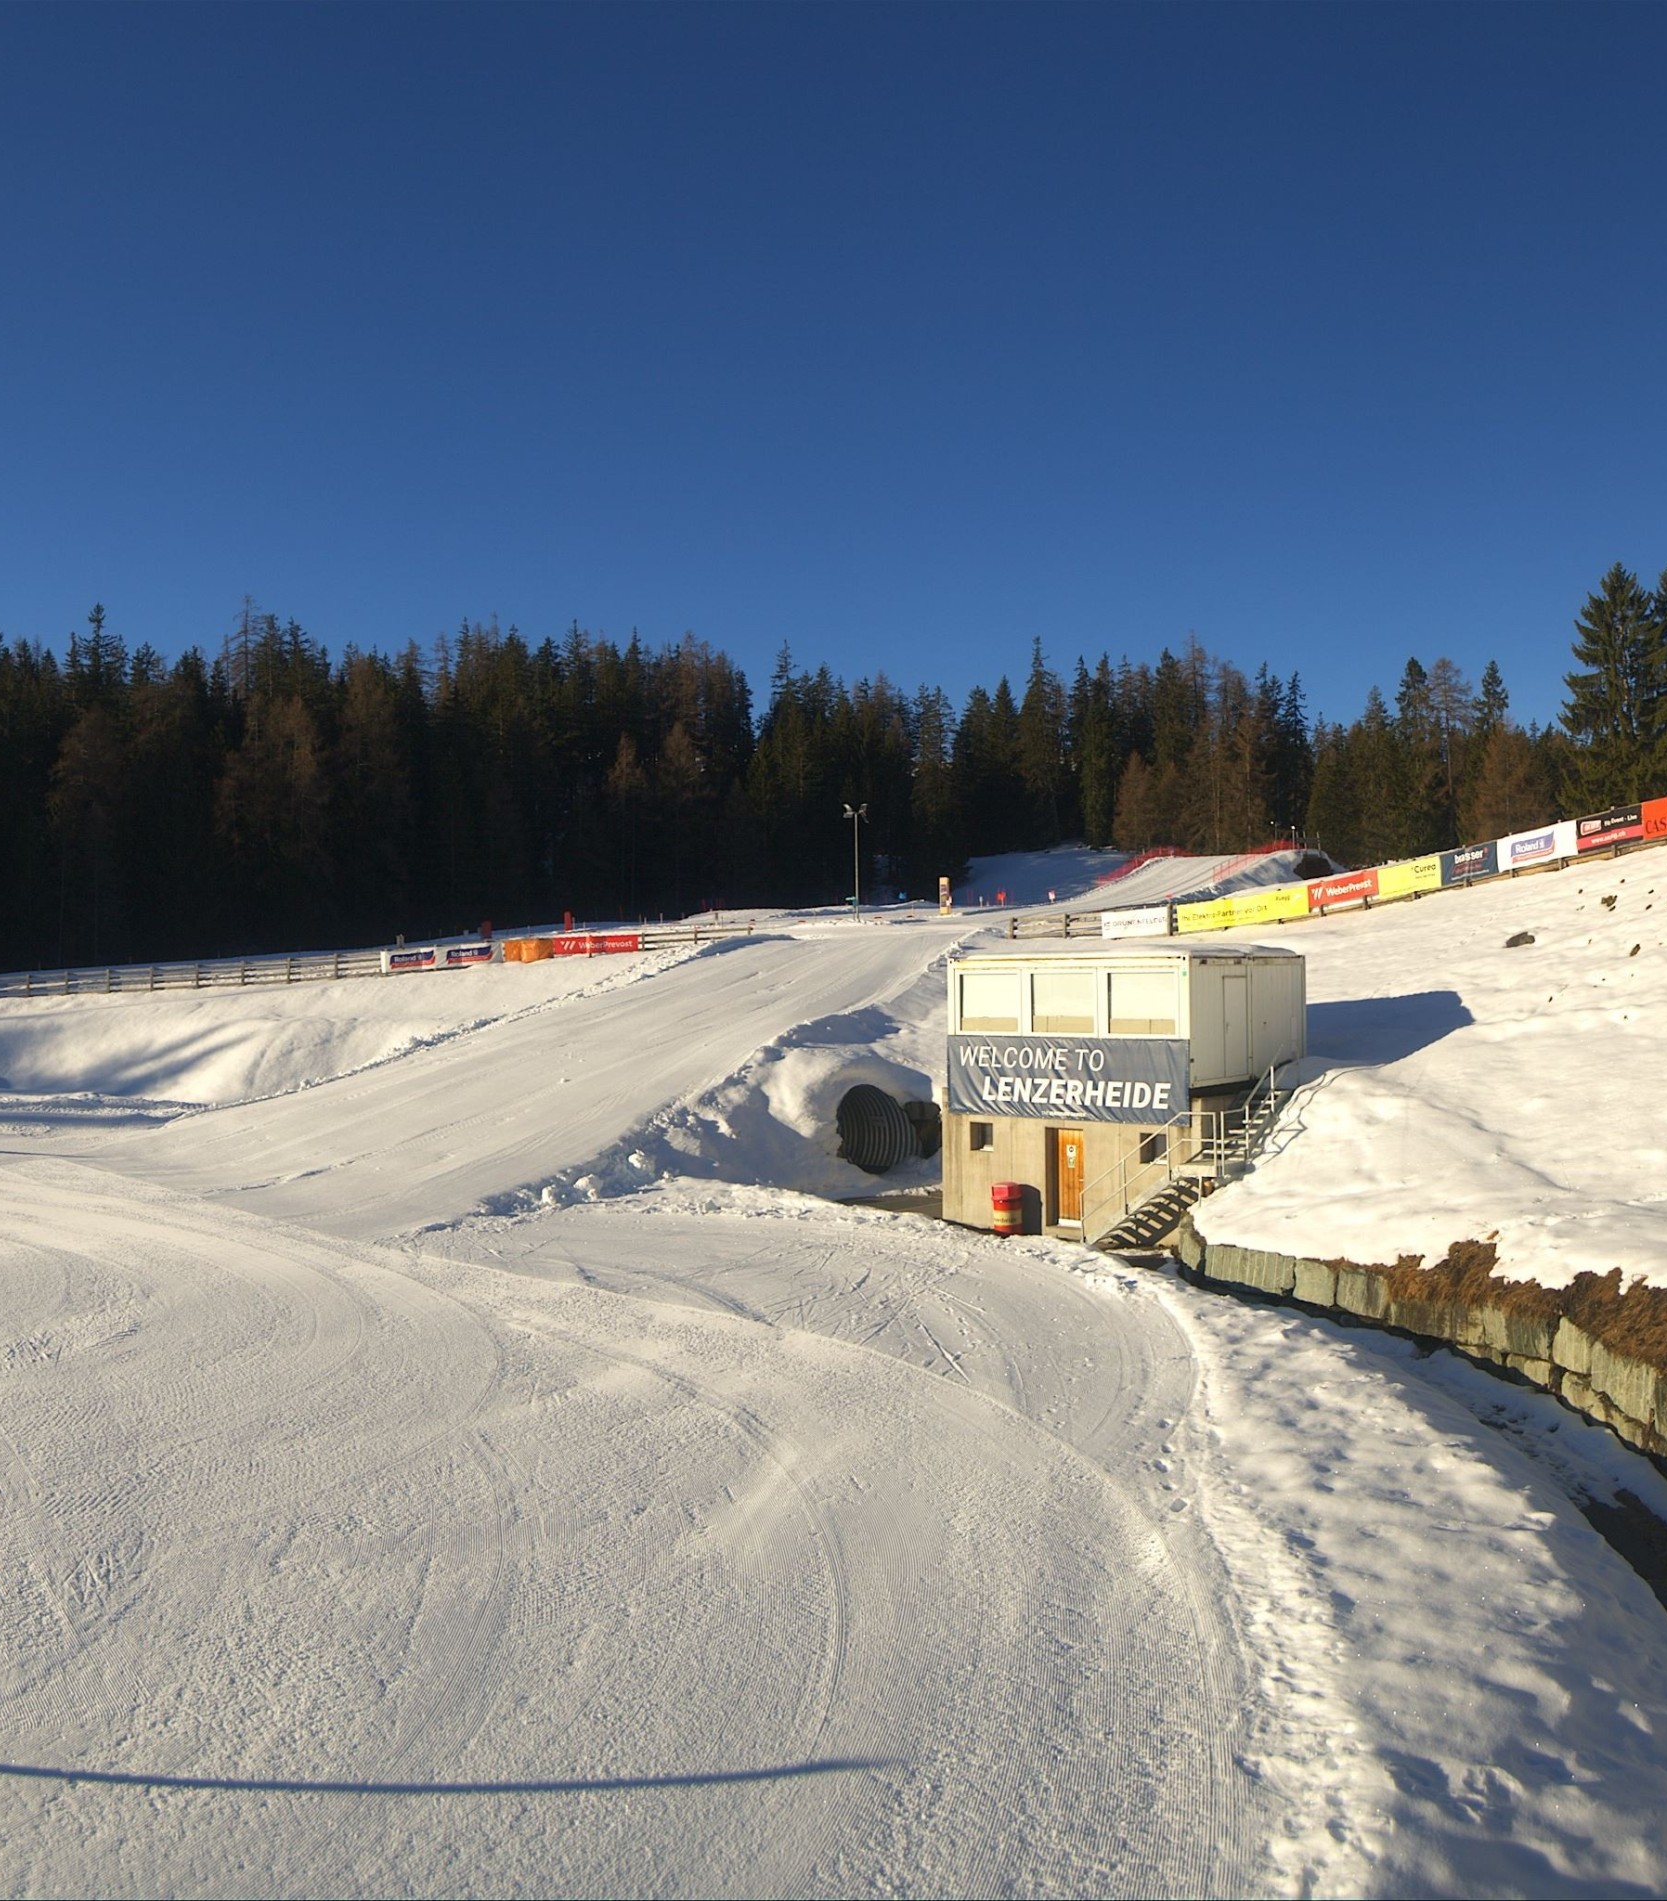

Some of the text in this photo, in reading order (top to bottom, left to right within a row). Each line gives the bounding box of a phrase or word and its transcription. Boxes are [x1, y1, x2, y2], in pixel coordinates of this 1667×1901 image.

[1514, 840, 1539, 854] Roland
[1325, 878, 1373, 898] WeberPrevost
[394, 954, 417, 963] Roland
[451, 949, 472, 958] Roland
[958, 1045, 1105, 1072] WELCOME TO
[981, 1075, 1172, 1110] LENZERHEIDE
